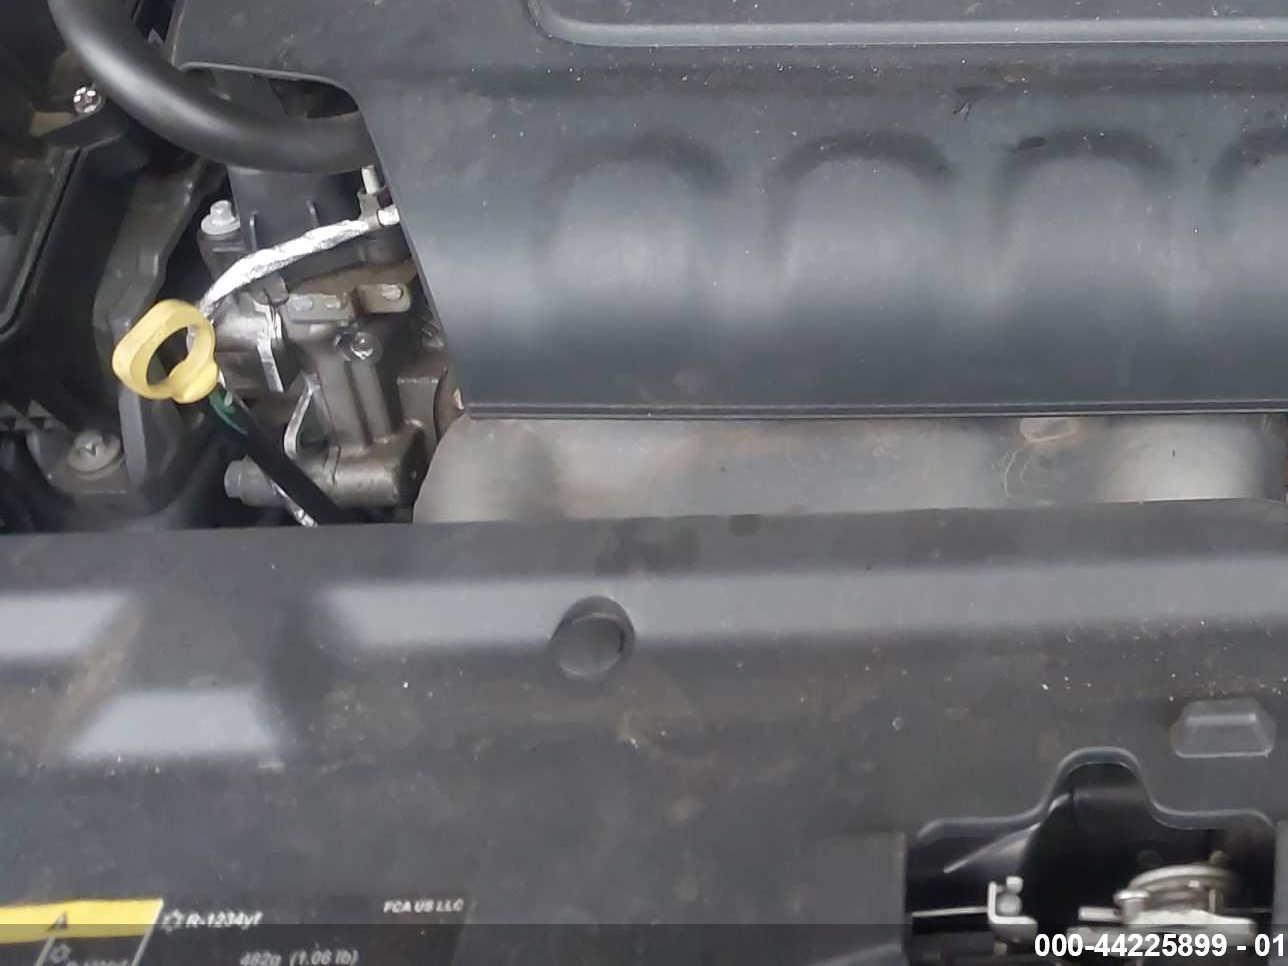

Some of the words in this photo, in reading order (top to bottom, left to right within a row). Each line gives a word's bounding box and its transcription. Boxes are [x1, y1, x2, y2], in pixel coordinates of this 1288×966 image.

[383, 899, 411, 914] FCA
[415, 899, 434, 913] US
[436, 898, 465, 912] LLC
[186, 911, 264, 931] R-1234yf
